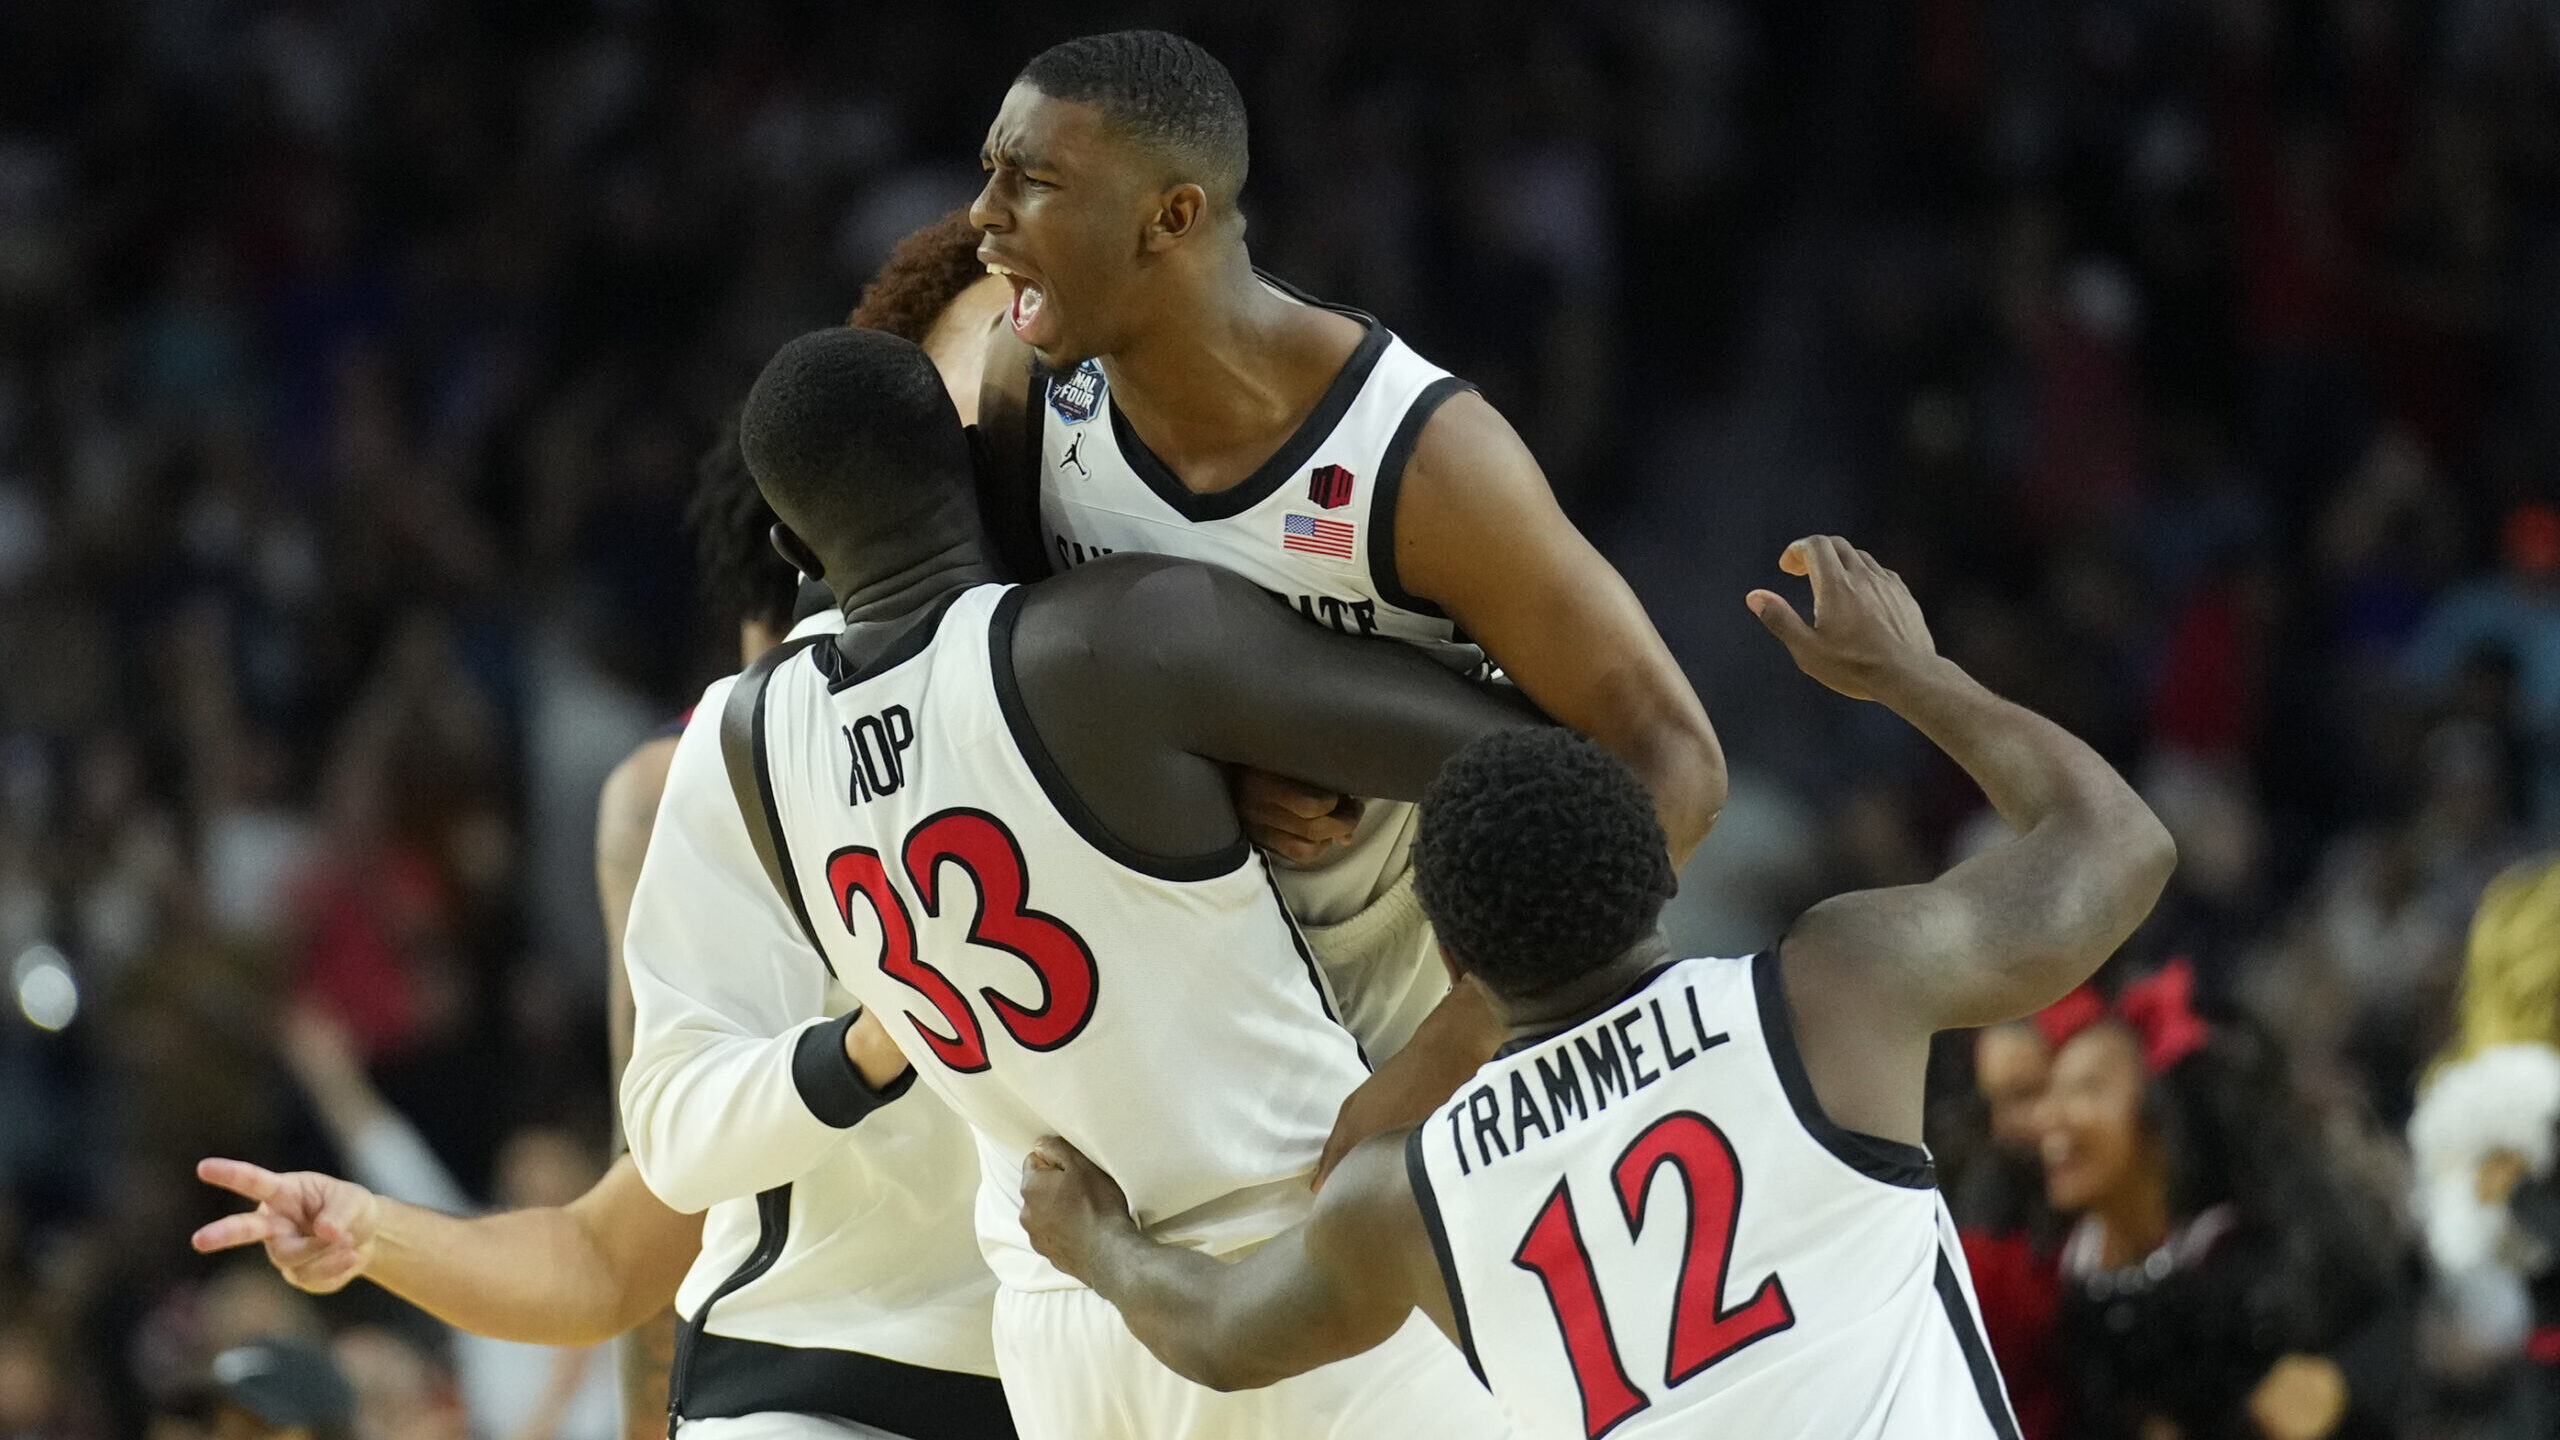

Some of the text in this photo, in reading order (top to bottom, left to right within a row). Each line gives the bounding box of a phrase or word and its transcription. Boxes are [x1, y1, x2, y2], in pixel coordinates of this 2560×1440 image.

[1059, 384, 1094, 410] FOUR
[826, 807, 1099, 1074] 33
[1447, 985, 1730, 1176] TRAMMELL
[1511, 1109, 1796, 1440] 12
